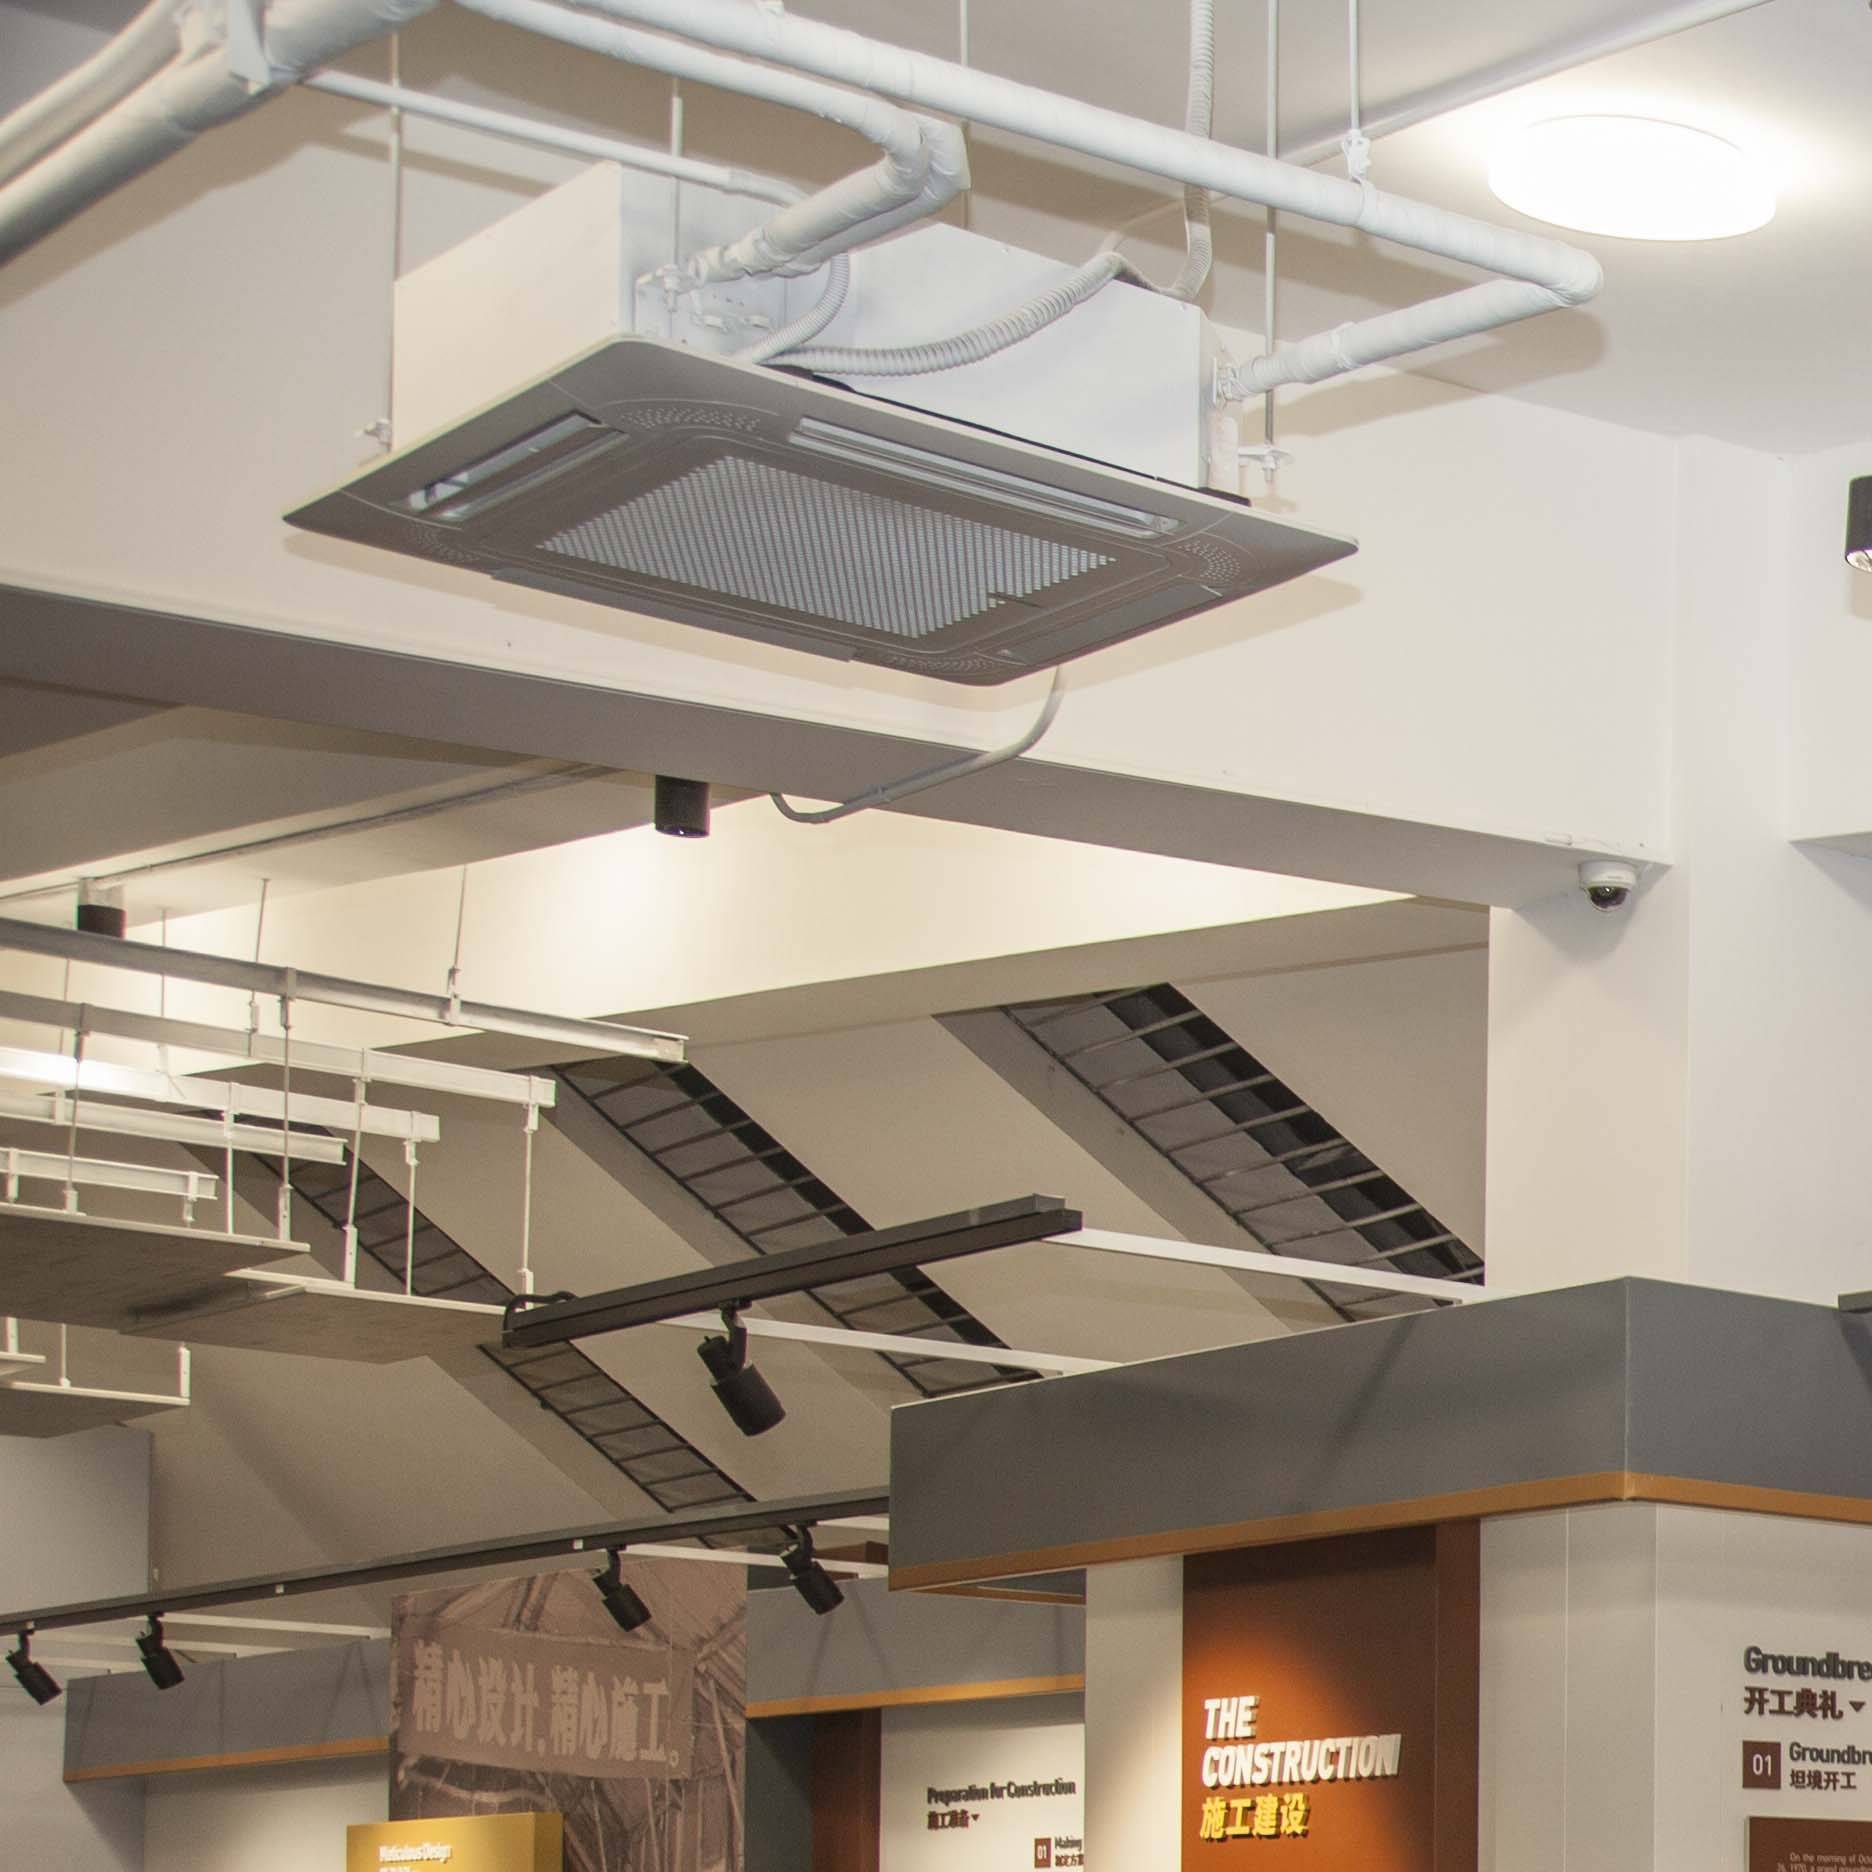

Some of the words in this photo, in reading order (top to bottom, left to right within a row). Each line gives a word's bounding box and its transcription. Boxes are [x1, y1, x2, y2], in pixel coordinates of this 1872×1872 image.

[1744, 1686, 1844, 1720] 开工典礼
[1204, 1695, 1258, 1740] THE
[1202, 1733, 1401, 1788] CONSTRUCTION
[1753, 1754, 1772, 1776] 01
[1007, 1778, 1076, 1798] Construction
[1790, 1769, 1857, 1791] 坦境开工
[1200, 1792, 1309, 1840] 施工建设
[1037, 1845, 1047, 1859] 01
